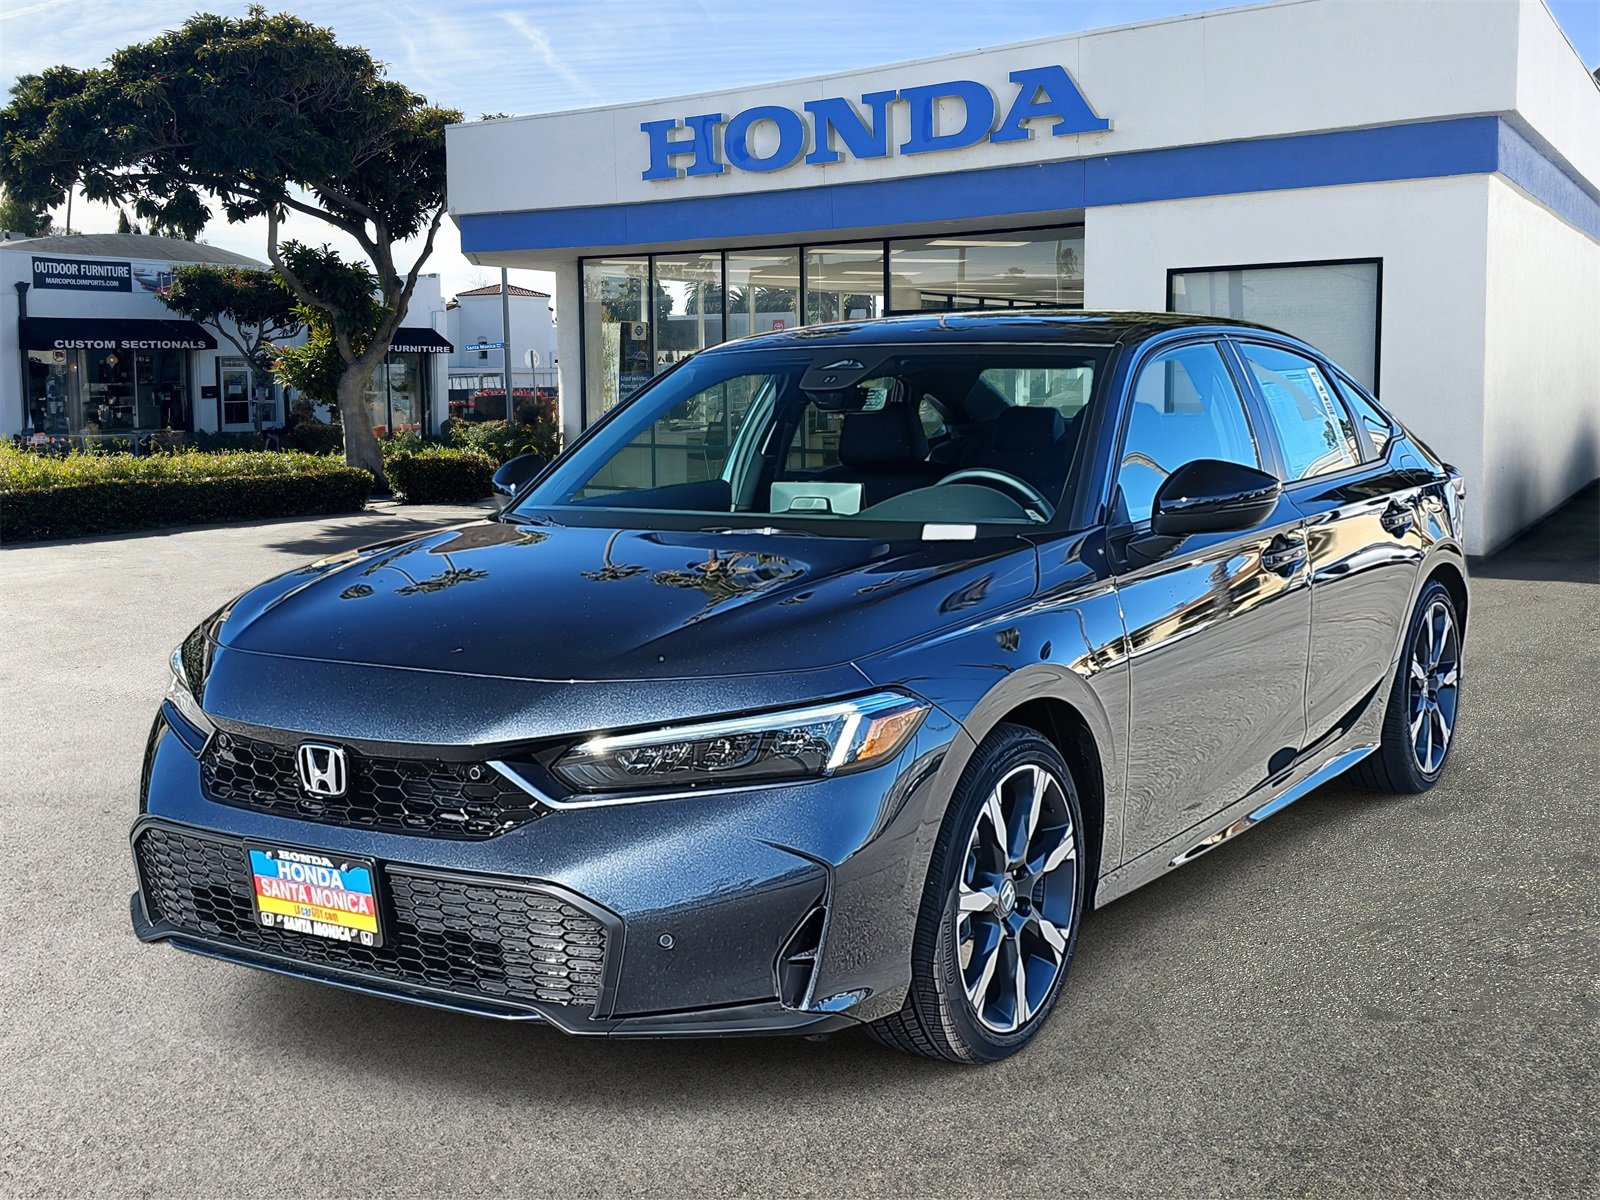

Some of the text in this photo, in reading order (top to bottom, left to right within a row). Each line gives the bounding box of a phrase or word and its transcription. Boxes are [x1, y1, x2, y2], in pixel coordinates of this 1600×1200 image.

[640, 64, 1113, 182] HONDA
[34, 261, 130, 278] OUTDOOR FURNITURE
[45, 277, 120, 287] MARCOPOLOIMPORTS.COM
[53, 339, 207, 349] CUSTOM SECTIONALS
[388, 344, 451, 353] FURNITURE
[277, 849, 334, 868] HONDA
[276, 860, 345, 890] HONDA
[260, 878, 370, 915] SANTA MONICA
[283, 914, 352, 942] SANTA MONICA
